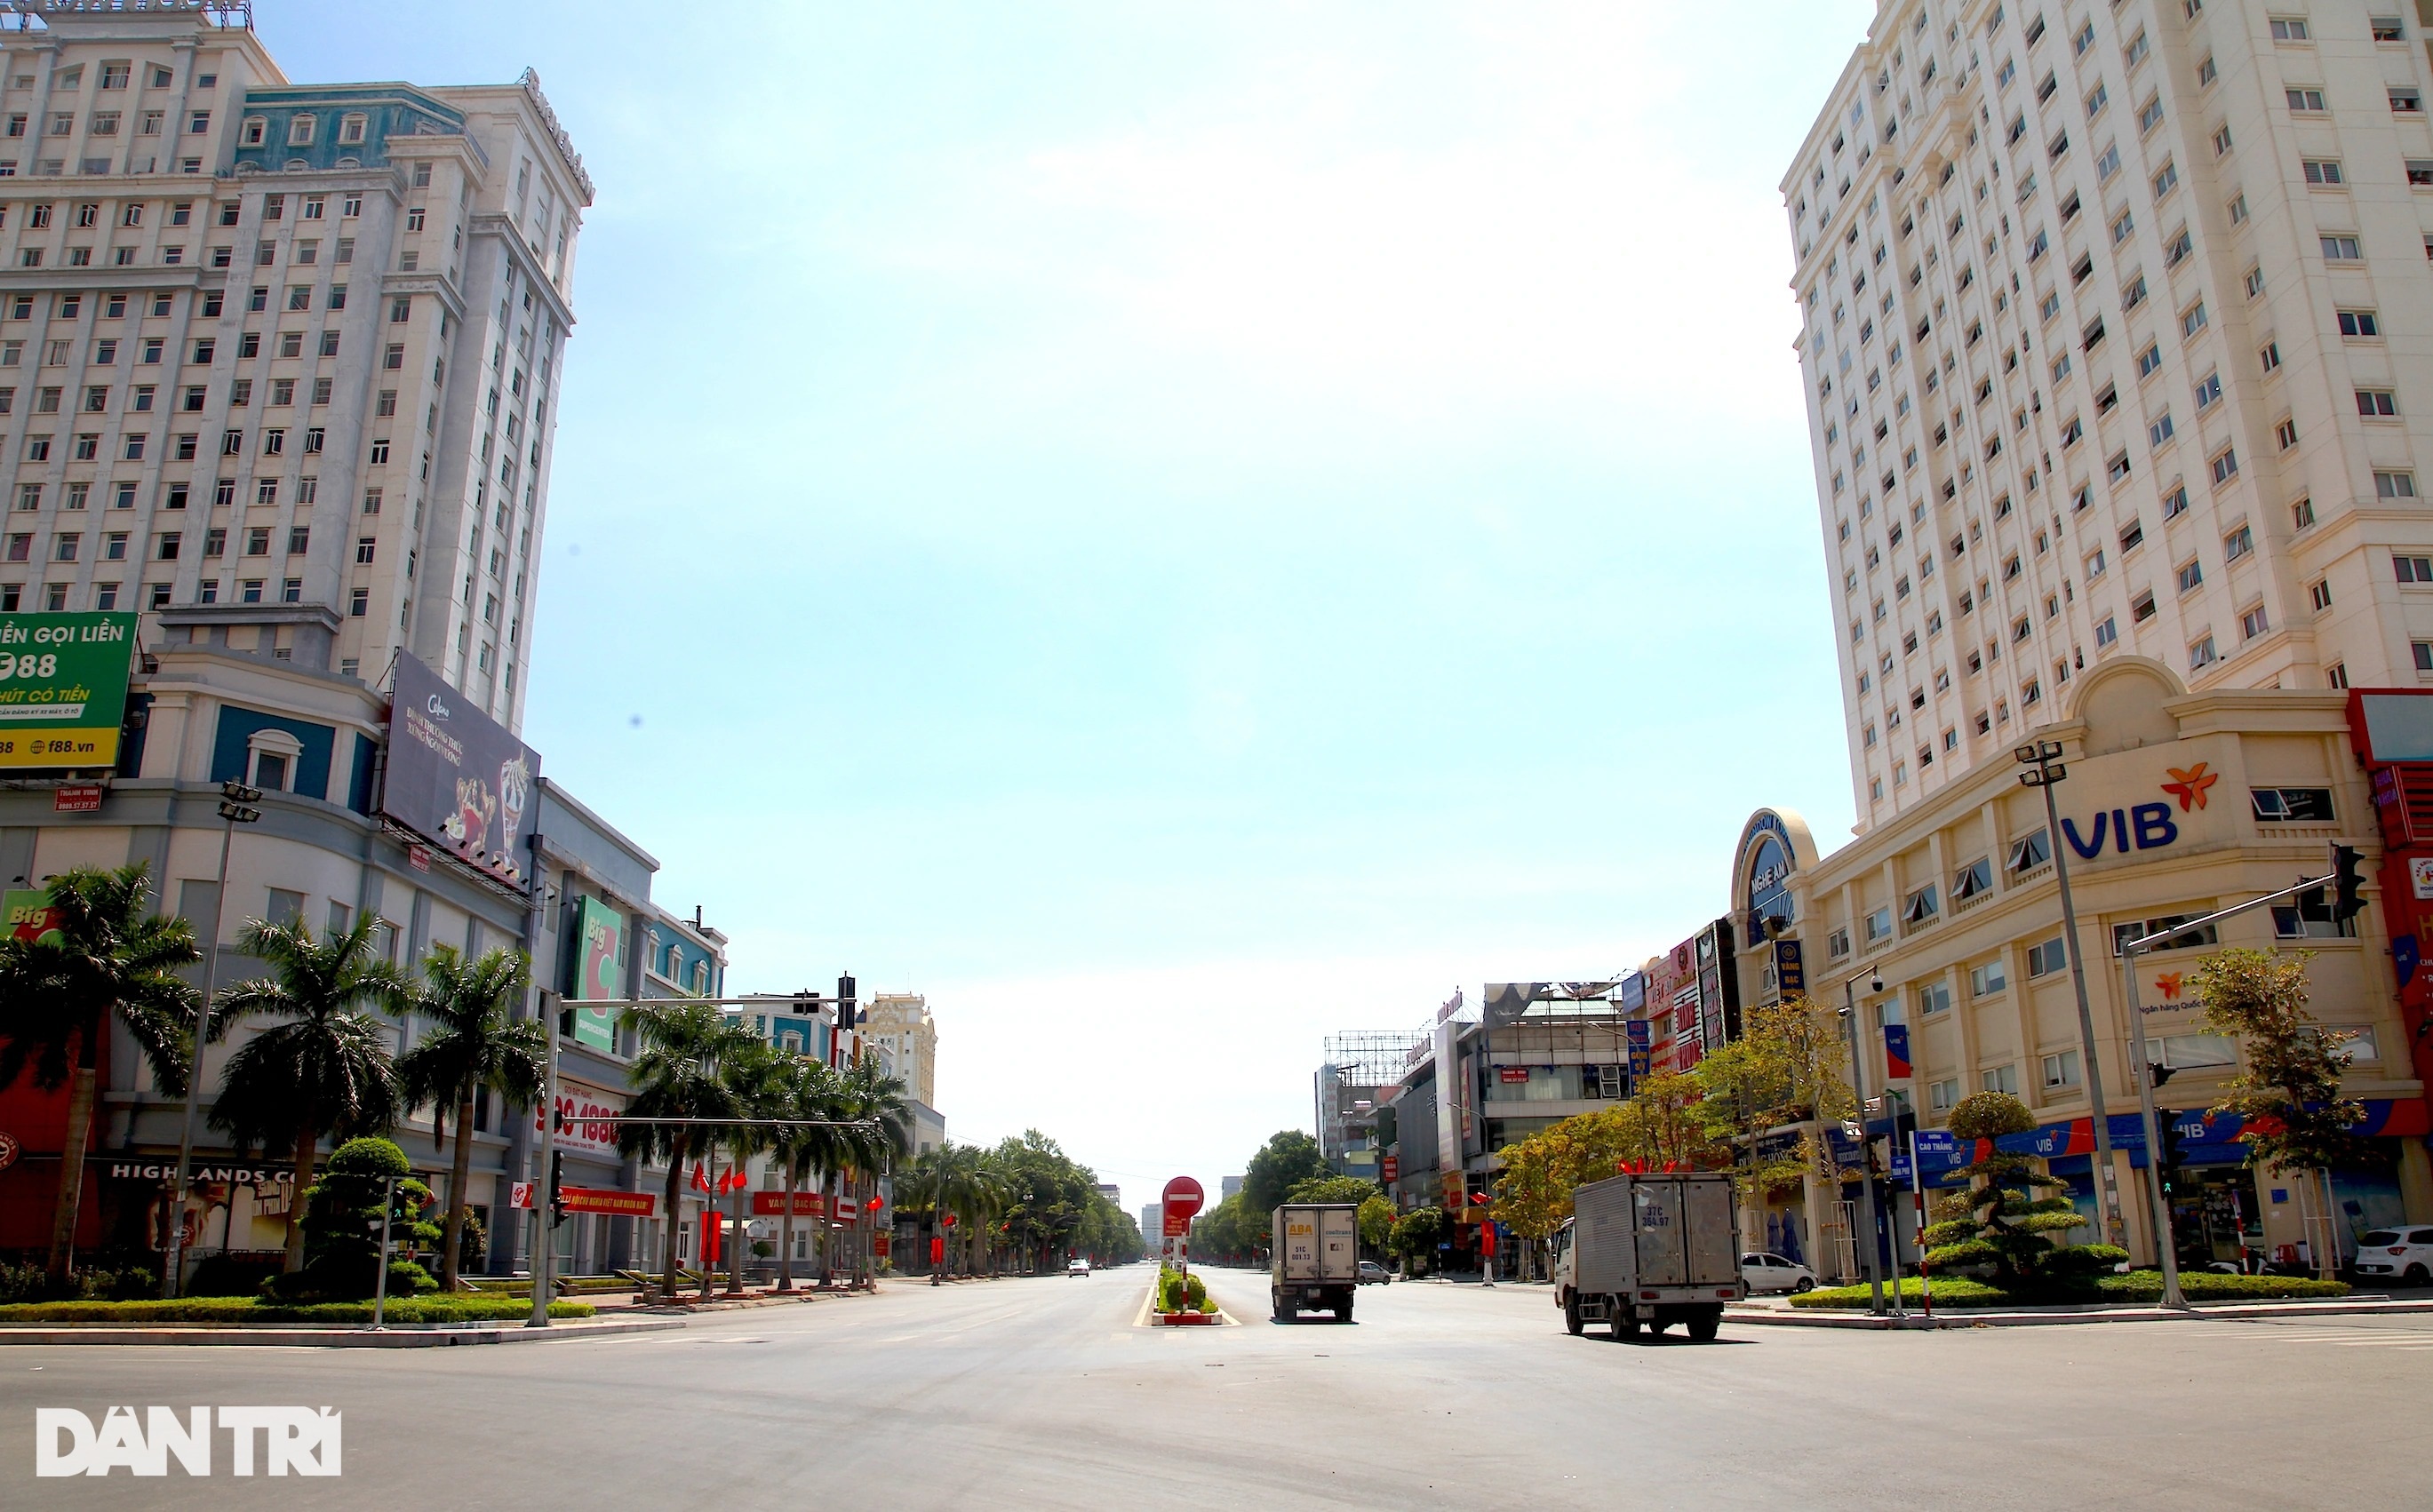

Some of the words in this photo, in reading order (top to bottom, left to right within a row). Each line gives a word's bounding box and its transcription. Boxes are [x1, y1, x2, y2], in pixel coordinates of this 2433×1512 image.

[34, 626, 76, 648] GỌI
[81, 617, 124, 642] LIỀN
[28, 687, 54, 703] CÓ
[58, 683, 91, 702] TIỀN
[48, 740, 95, 753] f88.vn
[2061, 801, 2178, 860] VIB
[1751, 868, 1775, 895] NGHỆ
[1773, 859, 1786, 880] AN
[9, 905, 49, 929] Big
[587, 916, 606, 951] Big
[1780, 961, 1800, 971] VÀNG
[2181, 999, 2201, 1009] Quốc
[578, 1019, 611, 1039] SUPERCENTER
[2035, 1137, 2054, 1153] VIB
[1947, 1152, 1962, 1166] VIB
[768, 1196, 786, 1208] VÀN
[1647, 1206, 1663, 1216] 37C
[1289, 1224, 1312, 1233] ABA
[1642, 1216, 1669, 1227] 364.97
